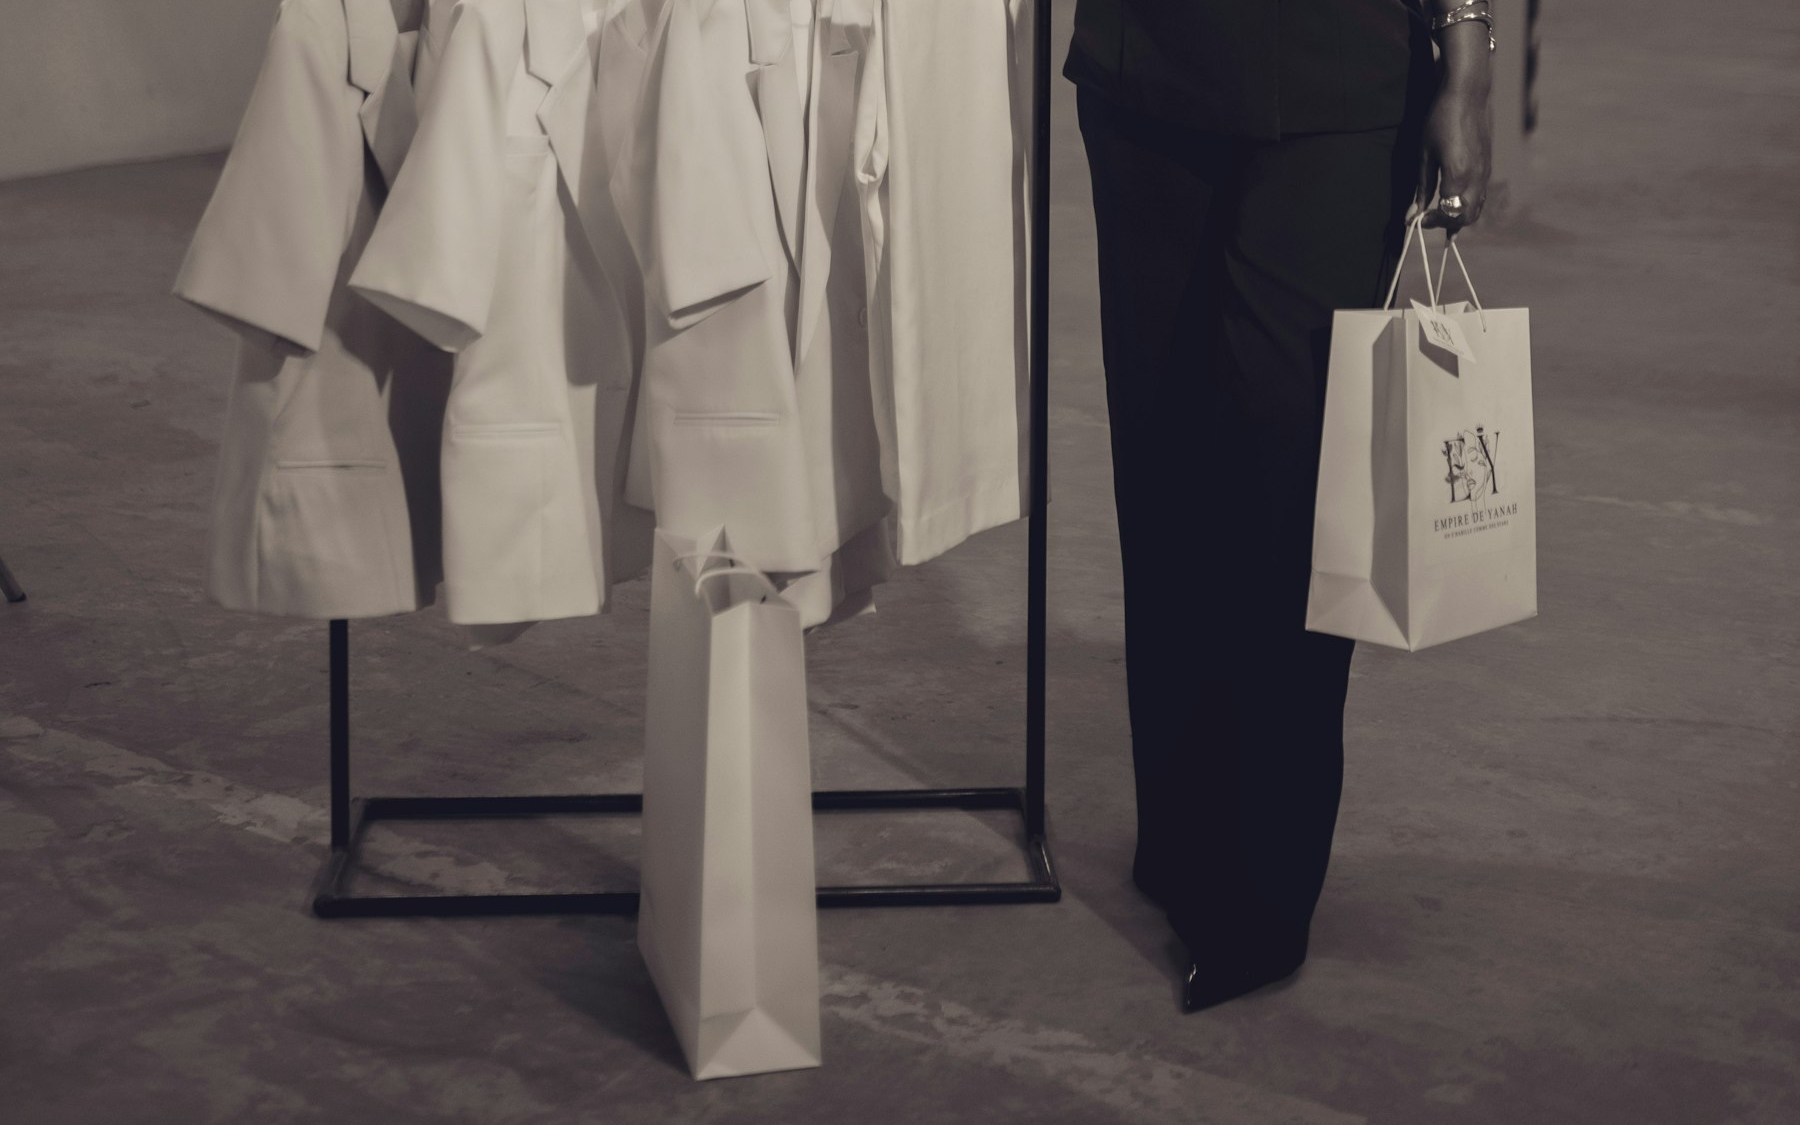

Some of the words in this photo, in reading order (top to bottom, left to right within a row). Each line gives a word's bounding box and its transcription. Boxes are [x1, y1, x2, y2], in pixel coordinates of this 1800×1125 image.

[1434, 512, 1469, 532] EMPIRE
[1472, 510, 1485, 524] DE
[1487, 503, 1518, 520] YANAH
